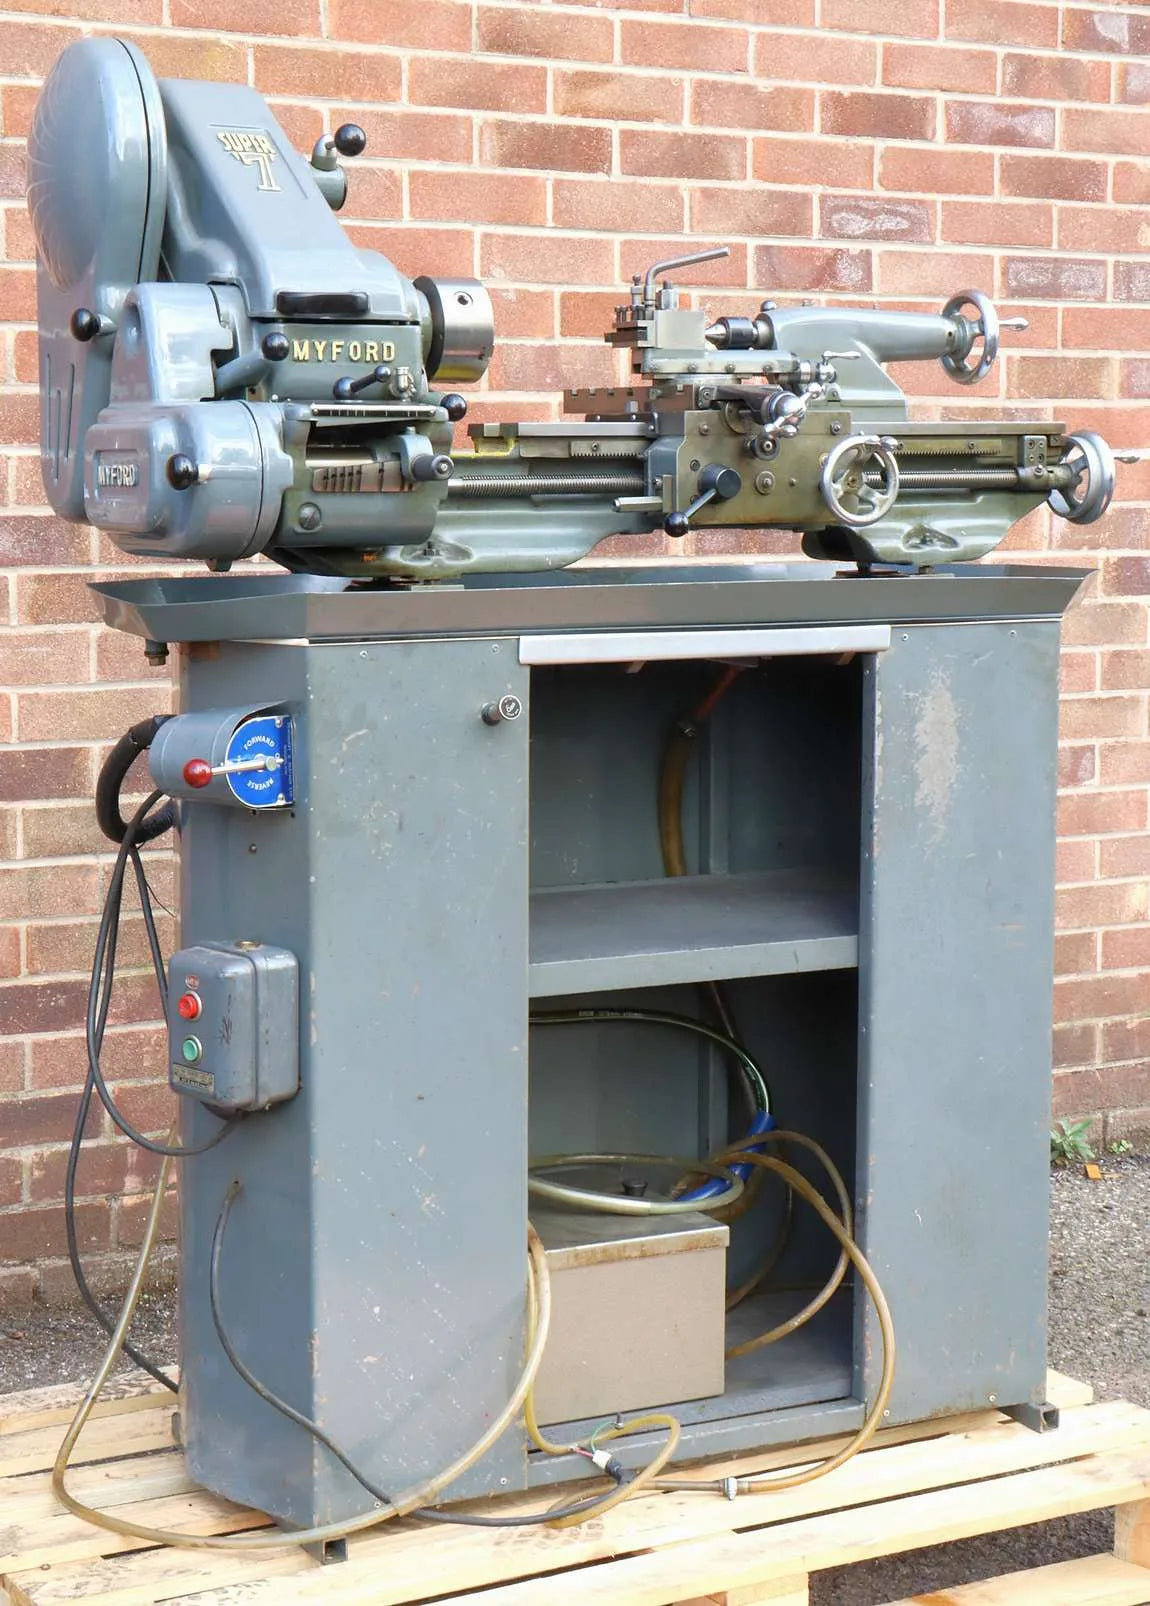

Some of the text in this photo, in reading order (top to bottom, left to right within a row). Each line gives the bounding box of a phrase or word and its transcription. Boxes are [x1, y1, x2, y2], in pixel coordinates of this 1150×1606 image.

[216, 132, 277, 155] SUPER
[231, 150, 281, 193] 7
[293, 339, 396, 363] MYFORD
[97, 464, 137, 488] MYFORD
[244, 735, 275, 750] FORWARD
[247, 778, 274, 790] REVERSE
